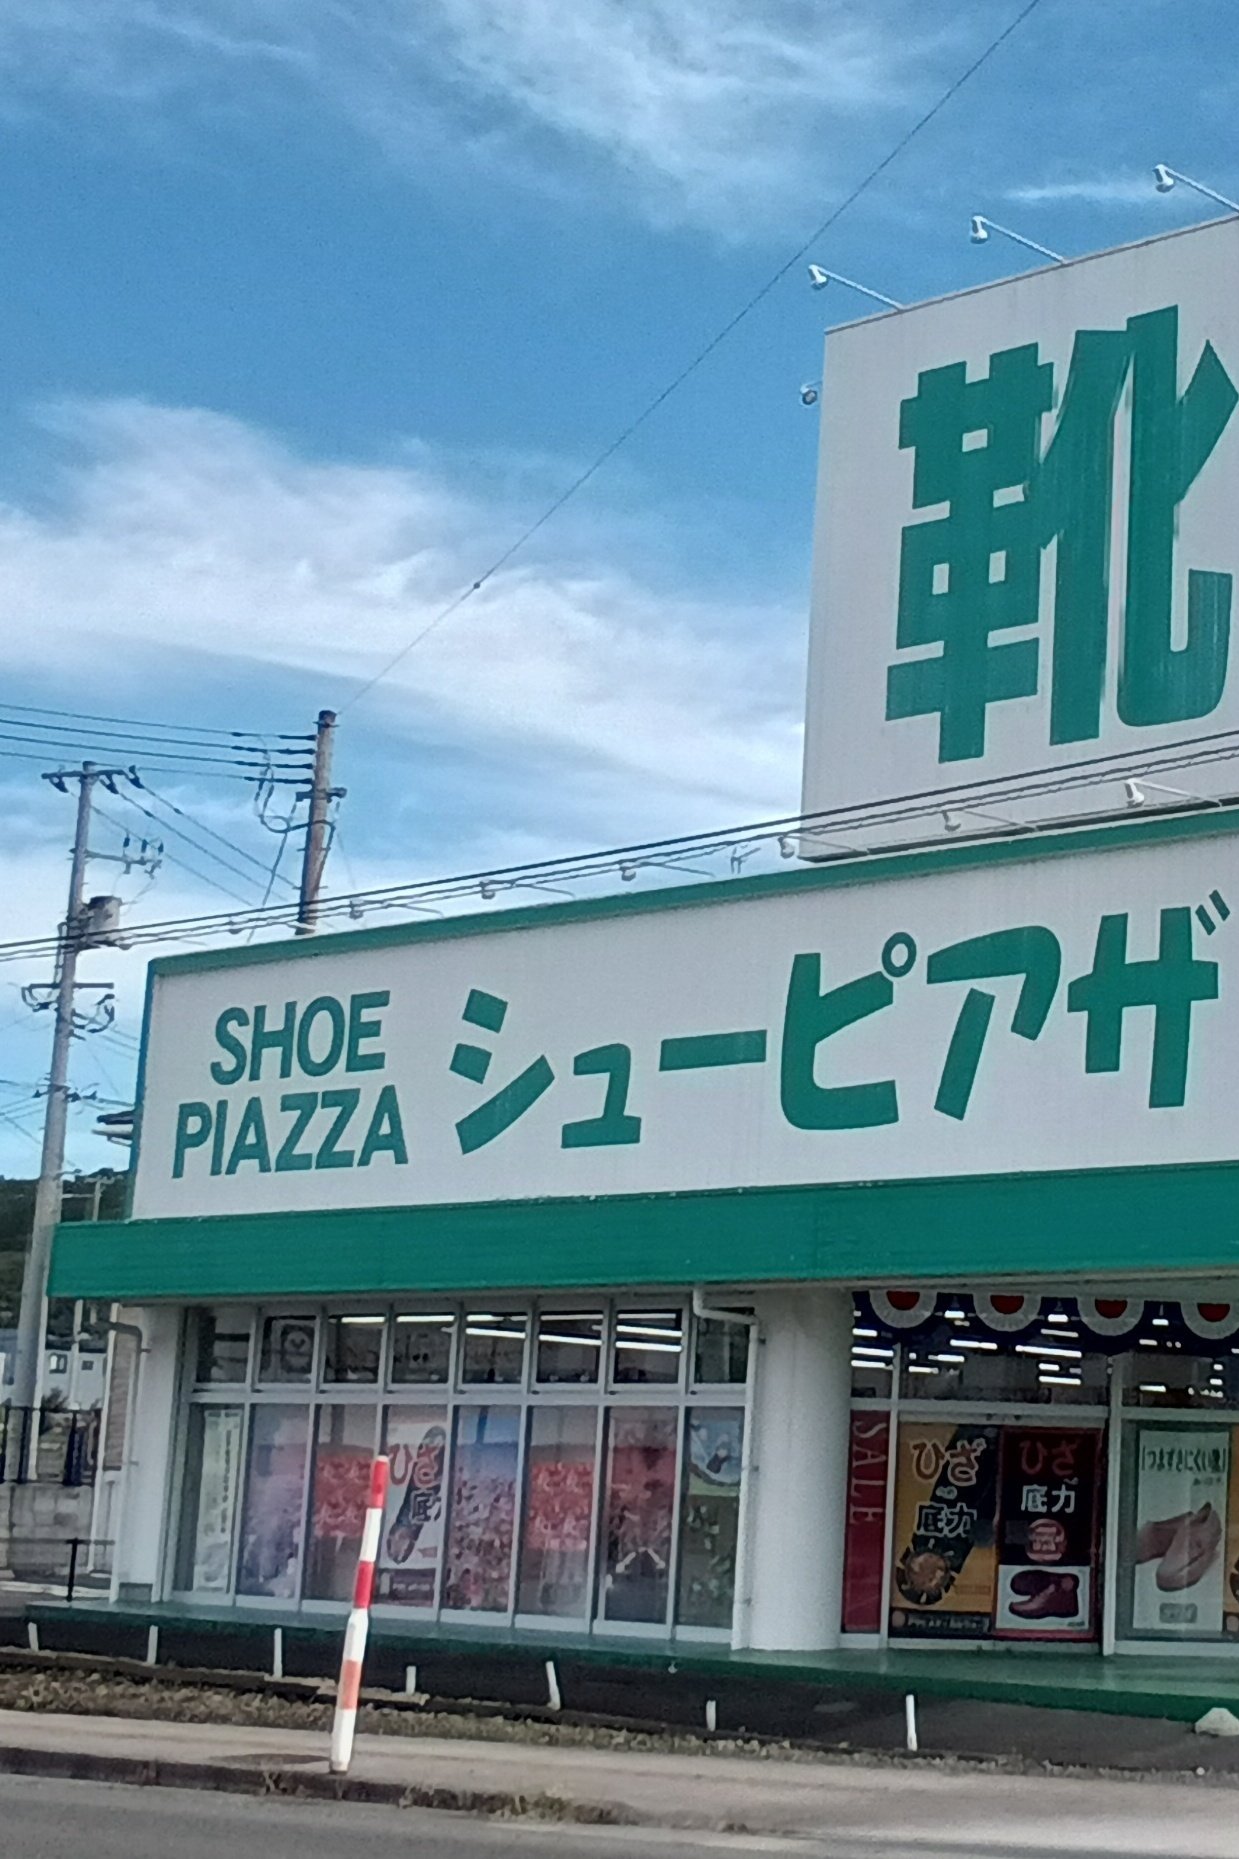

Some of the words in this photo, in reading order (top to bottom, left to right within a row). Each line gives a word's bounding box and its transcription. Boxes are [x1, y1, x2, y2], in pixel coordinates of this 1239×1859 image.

[886, 304, 1239, 764] 靴
[210, 991, 391, 1087] SHOE
[449, 893, 1229, 1155] シューピアザ
[172, 1085, 409, 1179] PIAZZA
[849, 1420, 887, 1525] SALE
[911, 1437, 986, 1486] ひざ
[1020, 1483, 1077, 1514] 底力
